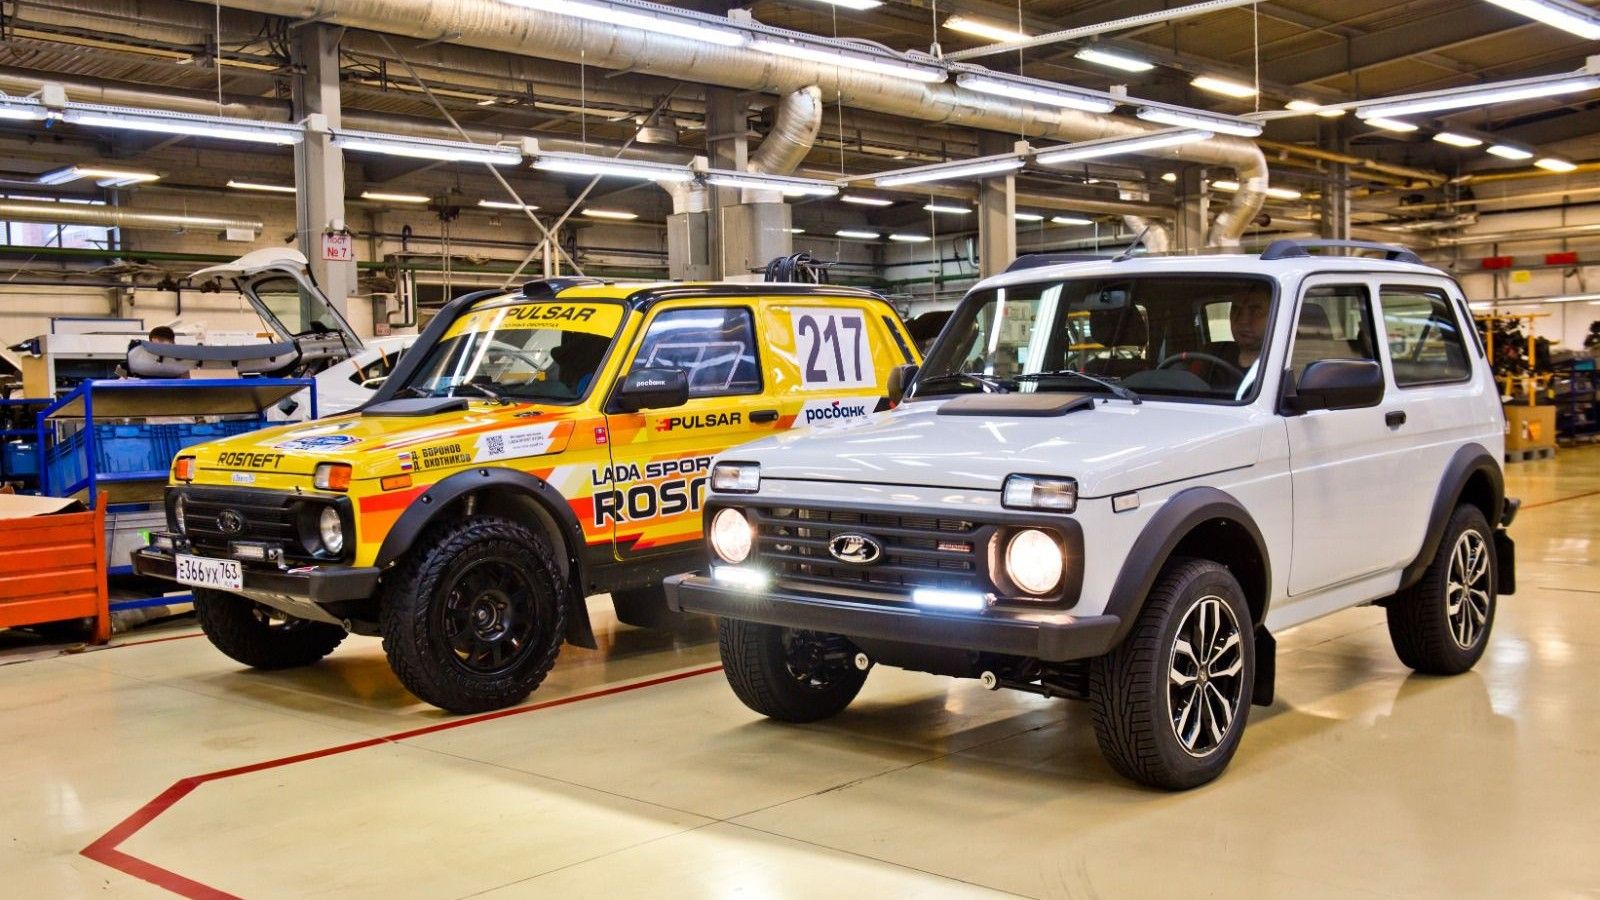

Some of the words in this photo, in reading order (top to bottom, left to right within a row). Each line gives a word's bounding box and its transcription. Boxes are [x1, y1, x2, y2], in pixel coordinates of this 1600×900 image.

[342, 248, 347, 257] 7
[506, 306, 596, 321] PULSAR
[799, 315, 862, 382] 217
[671, 412, 741, 430] PULSAR
[806, 401, 865, 424] росбанк
[218, 452, 285, 469] ROSNEFT
[592, 464, 641, 486] LADA
[220, 562, 238, 580] 763
